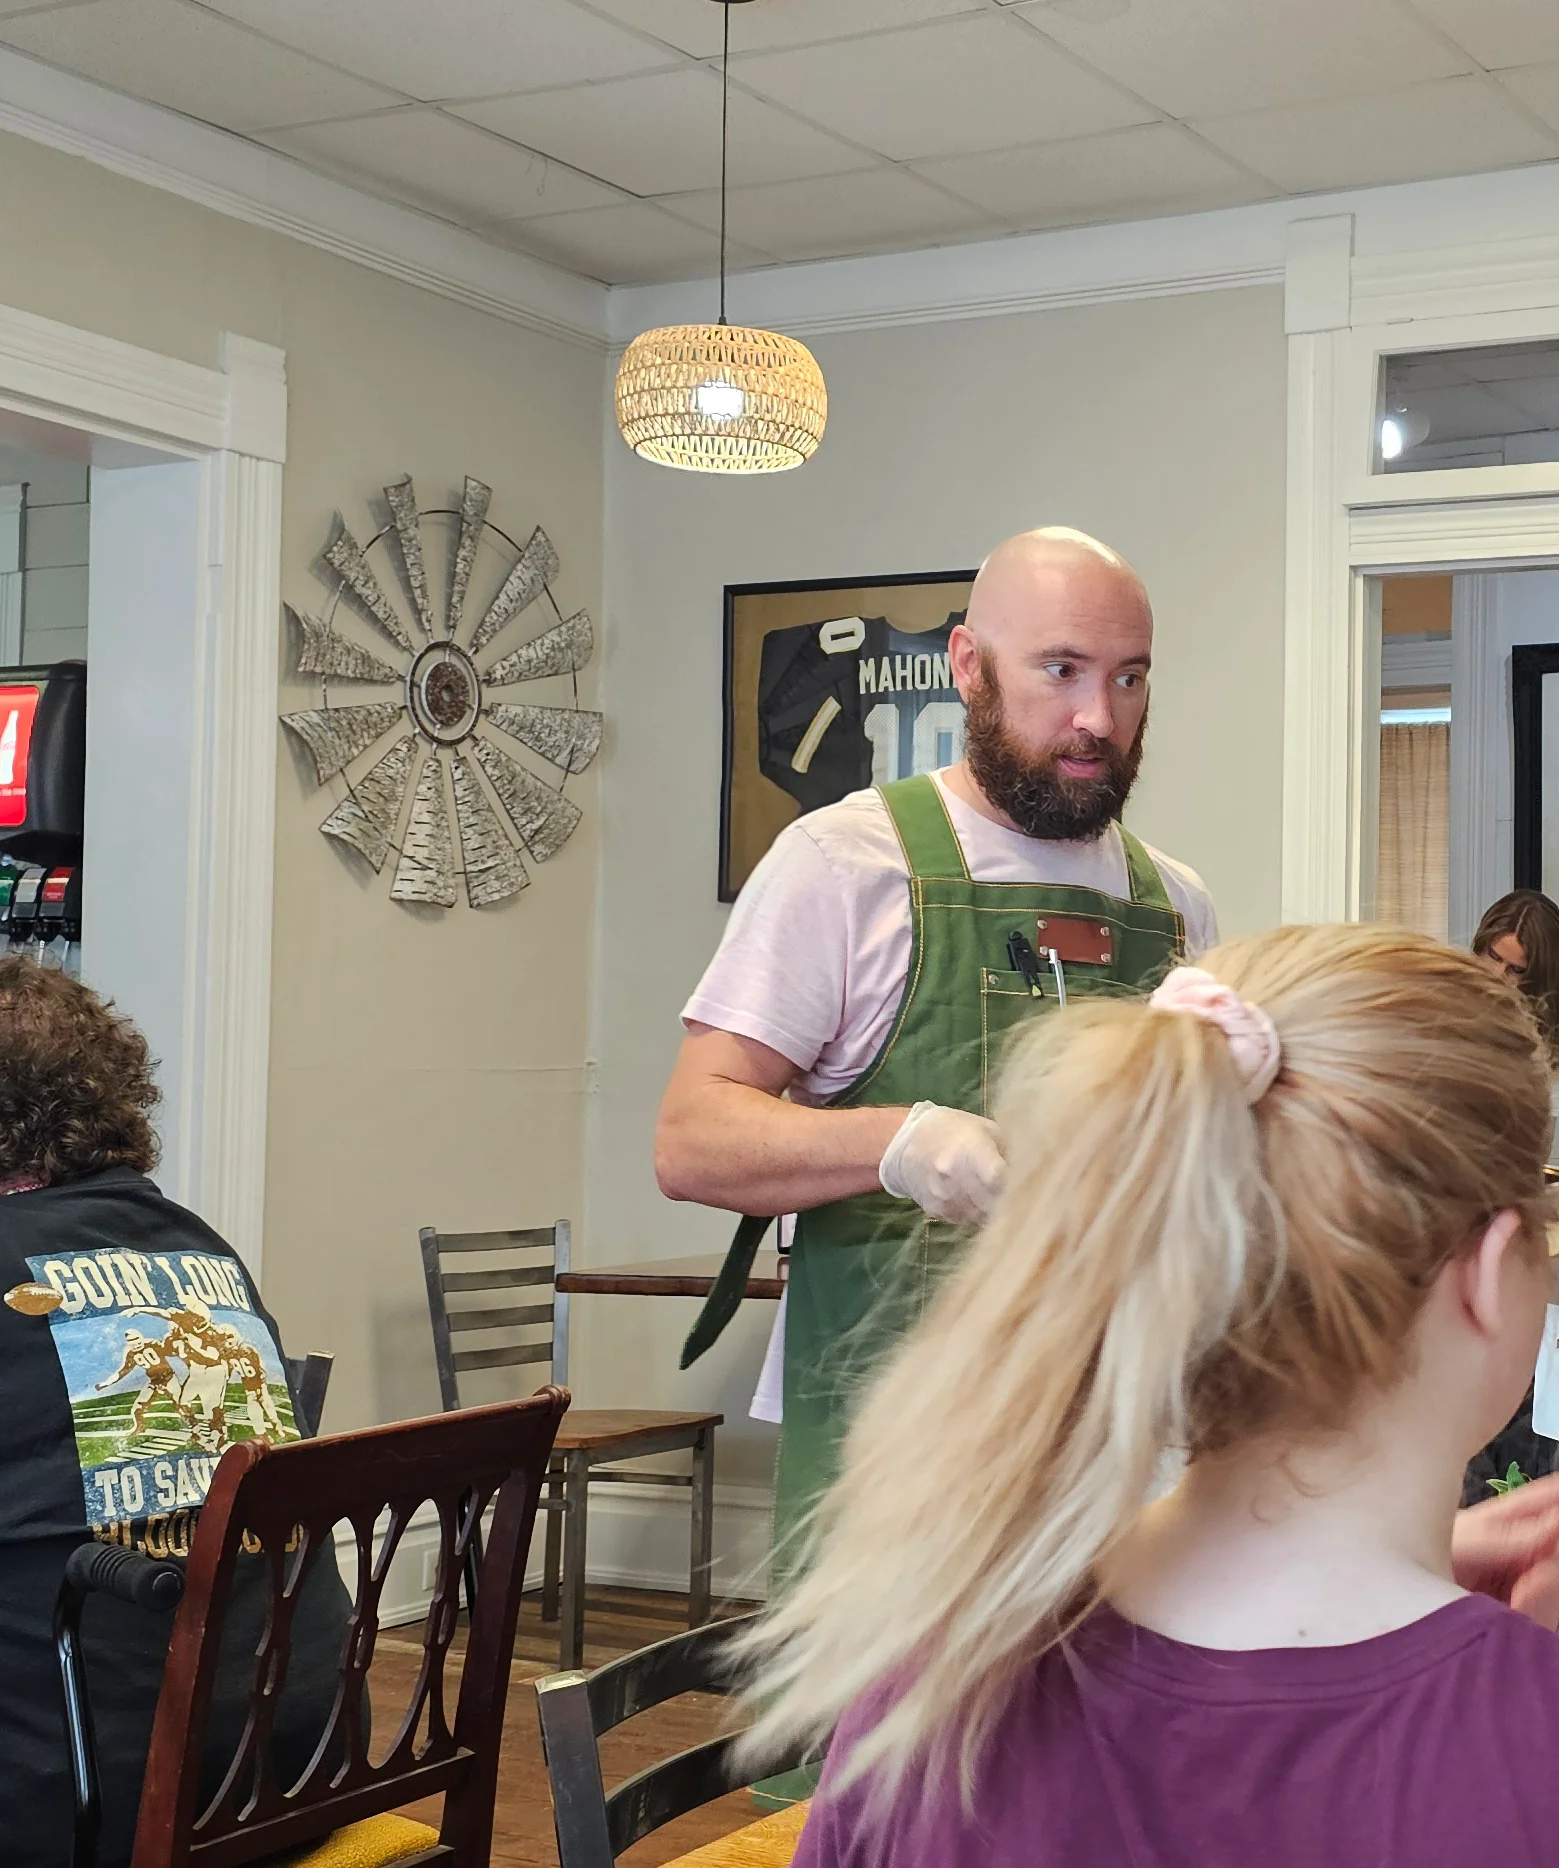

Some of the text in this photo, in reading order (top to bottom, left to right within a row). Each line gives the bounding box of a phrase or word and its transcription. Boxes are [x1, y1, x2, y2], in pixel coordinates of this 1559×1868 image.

[859, 652, 958, 695] MAHON
[159, 1256, 251, 1312] LONG
[95, 1456, 221, 1517] TO SAV
